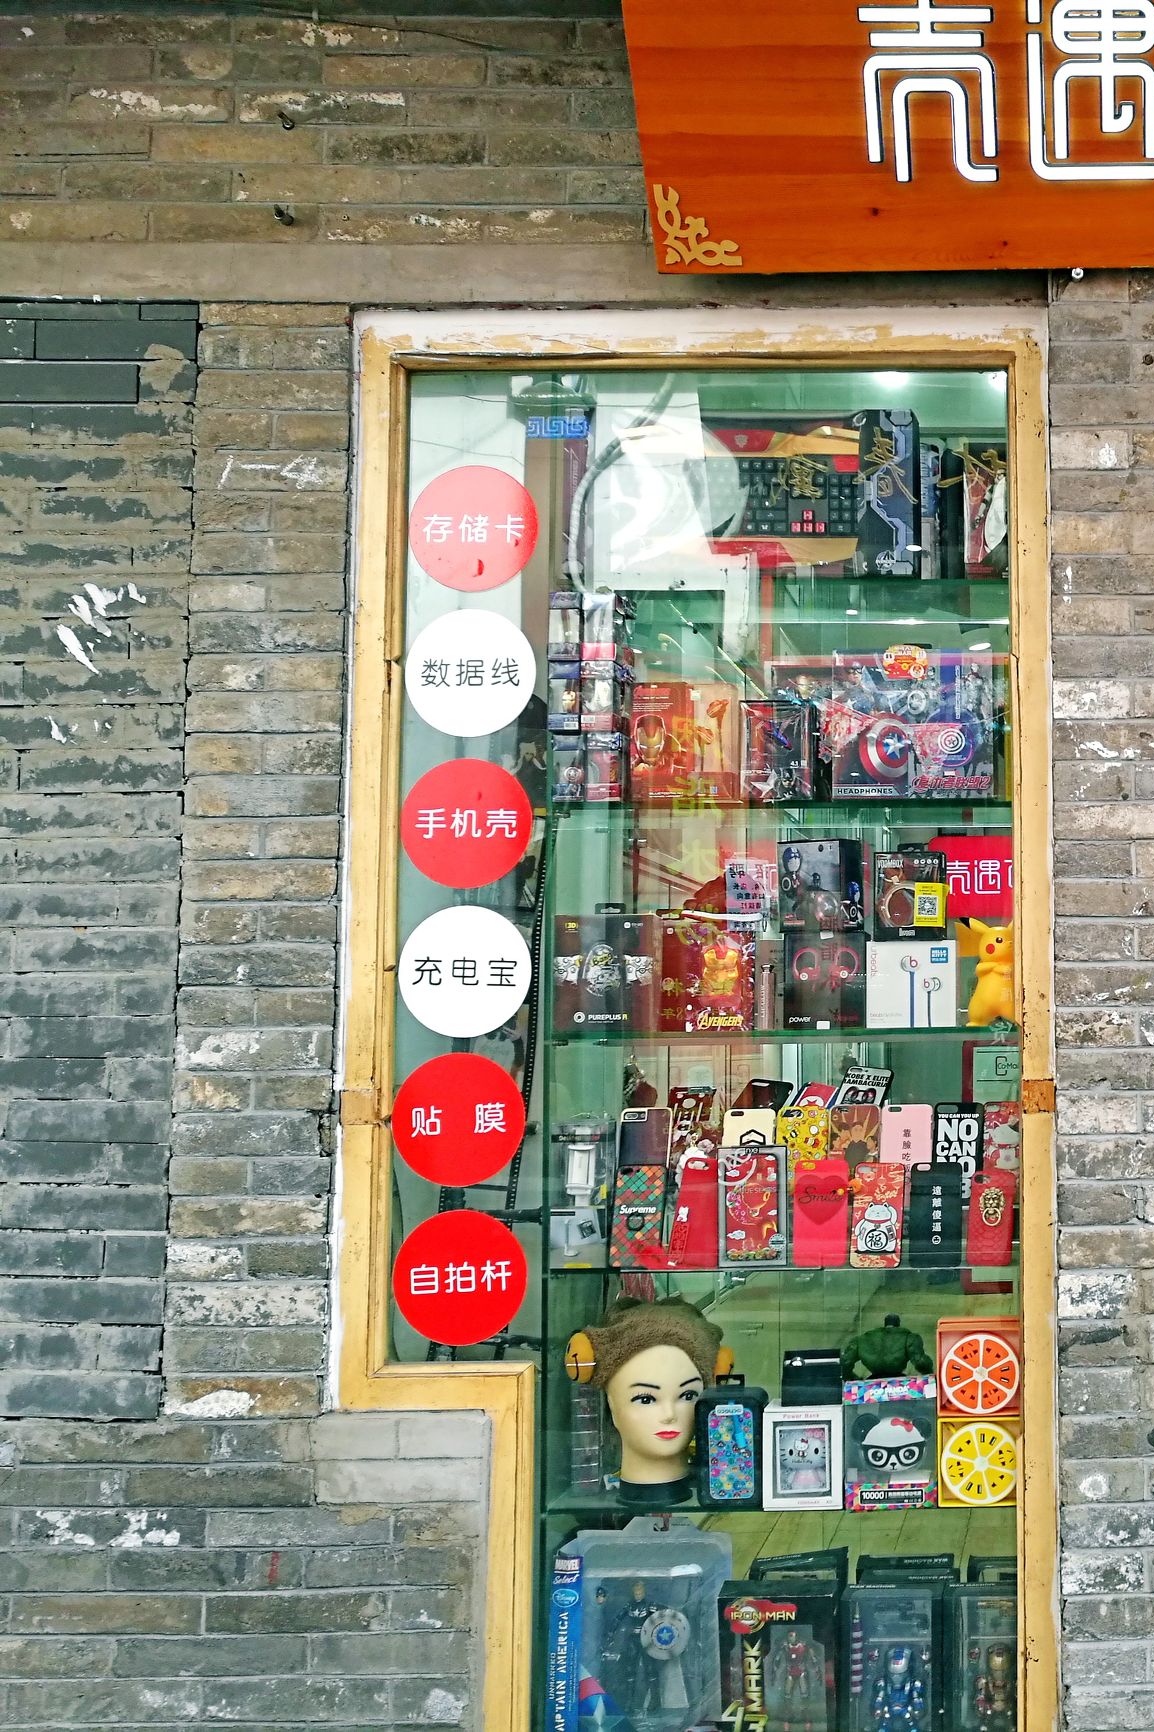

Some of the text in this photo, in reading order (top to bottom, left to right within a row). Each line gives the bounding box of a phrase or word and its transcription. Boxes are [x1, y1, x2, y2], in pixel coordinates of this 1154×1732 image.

[422, 514, 524, 544] 存储卡
[421, 657, 521, 687] 数据线
[837, 788, 894, 796] HEADPHONES
[414, 808, 518, 839] 手机壳
[412, 956, 518, 989] 充电宝
[788, 1015, 812, 1024] power
[411, 1101, 506, 1136] 贴膜
[937, 1118, 979, 1142] NO
[936, 1141, 976, 1157] CAN
[620, 1204, 657, 1215] Supreme
[868, 1232, 883, 1248] 福
[409, 1259, 513, 1296] 自拍杆
[862, 1491, 885, 1500] 10000
[553, 1573, 580, 1585] Select
[731, 1610, 796, 1621] IRON MAN
[559, 1612, 569, 1674] AMERICA
[743, 1639, 764, 1713] MARK
